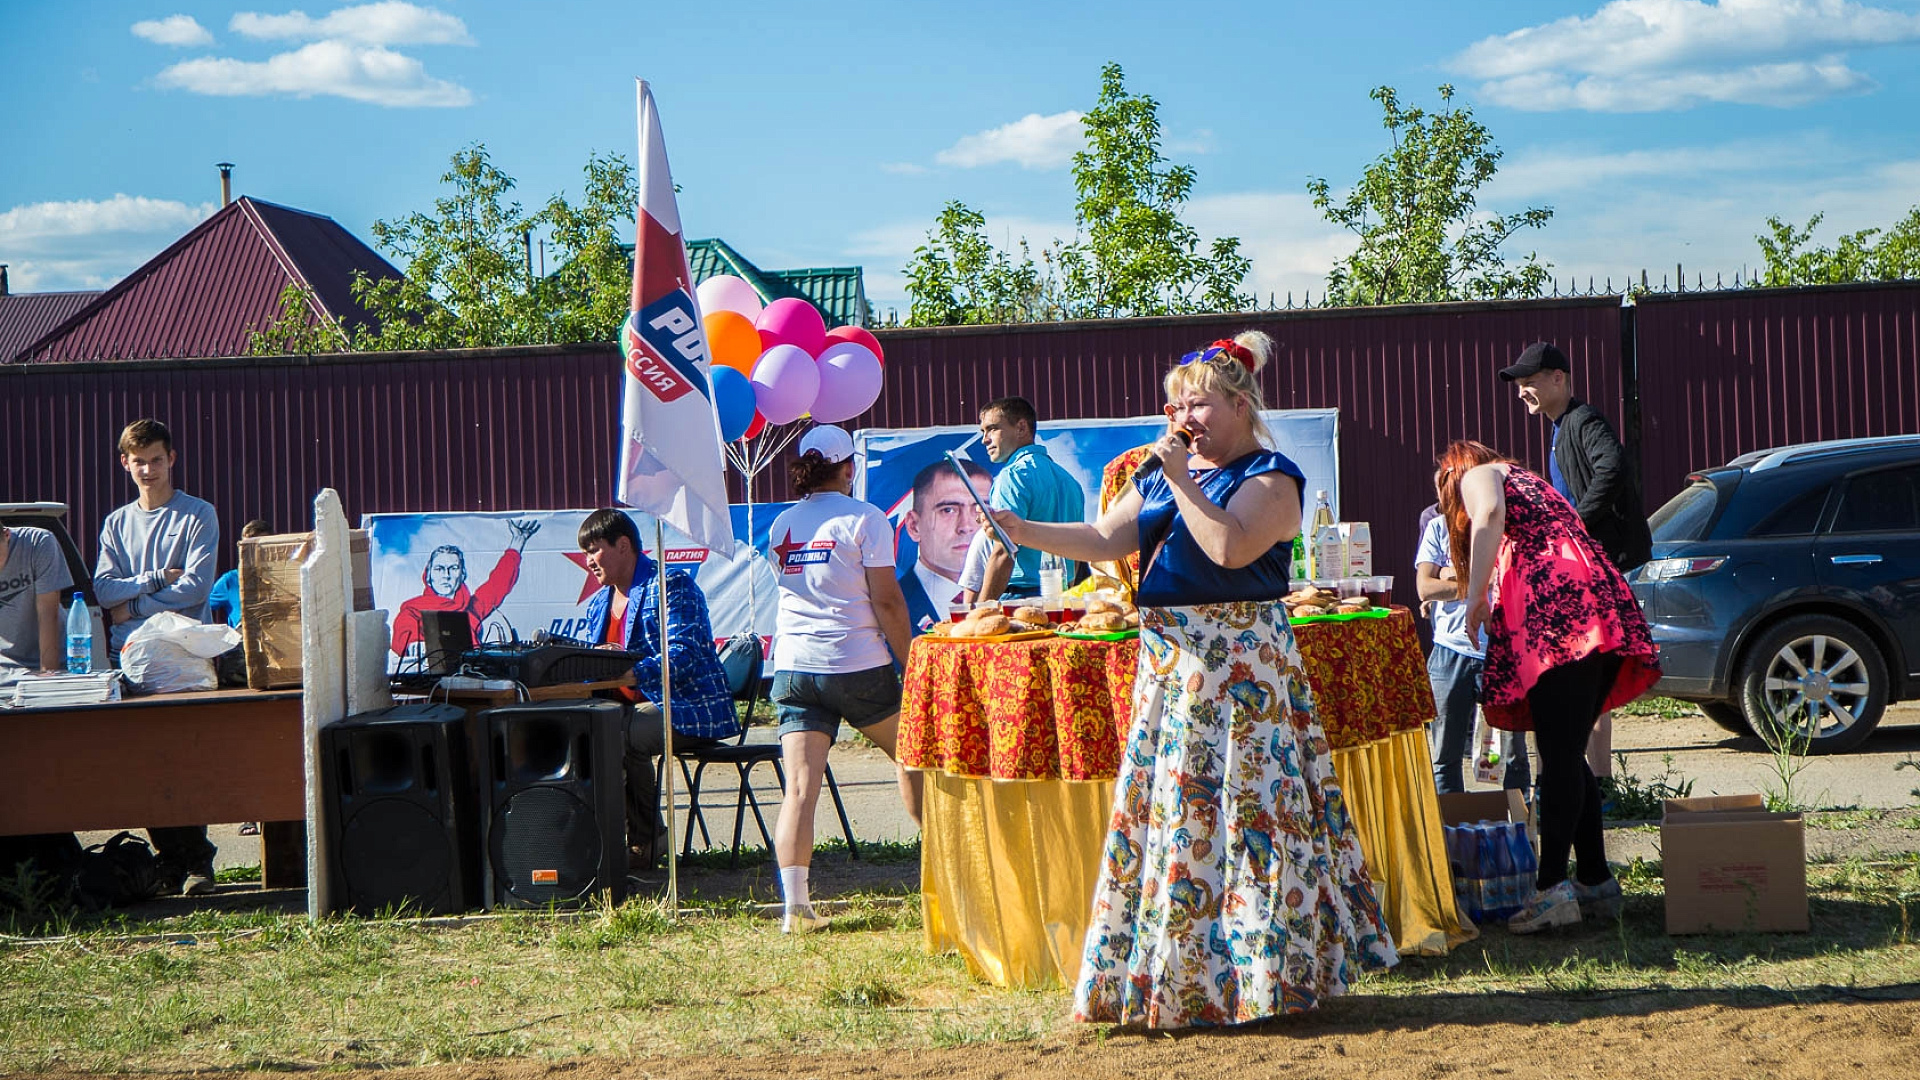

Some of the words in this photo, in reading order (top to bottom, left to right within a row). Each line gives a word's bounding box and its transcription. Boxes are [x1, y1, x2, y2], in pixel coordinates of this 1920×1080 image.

[666, 551, 704, 560] ПАРТИЯ
[788, 551, 828, 563] РОДИНА
[549, 618, 588, 639] ПАР
